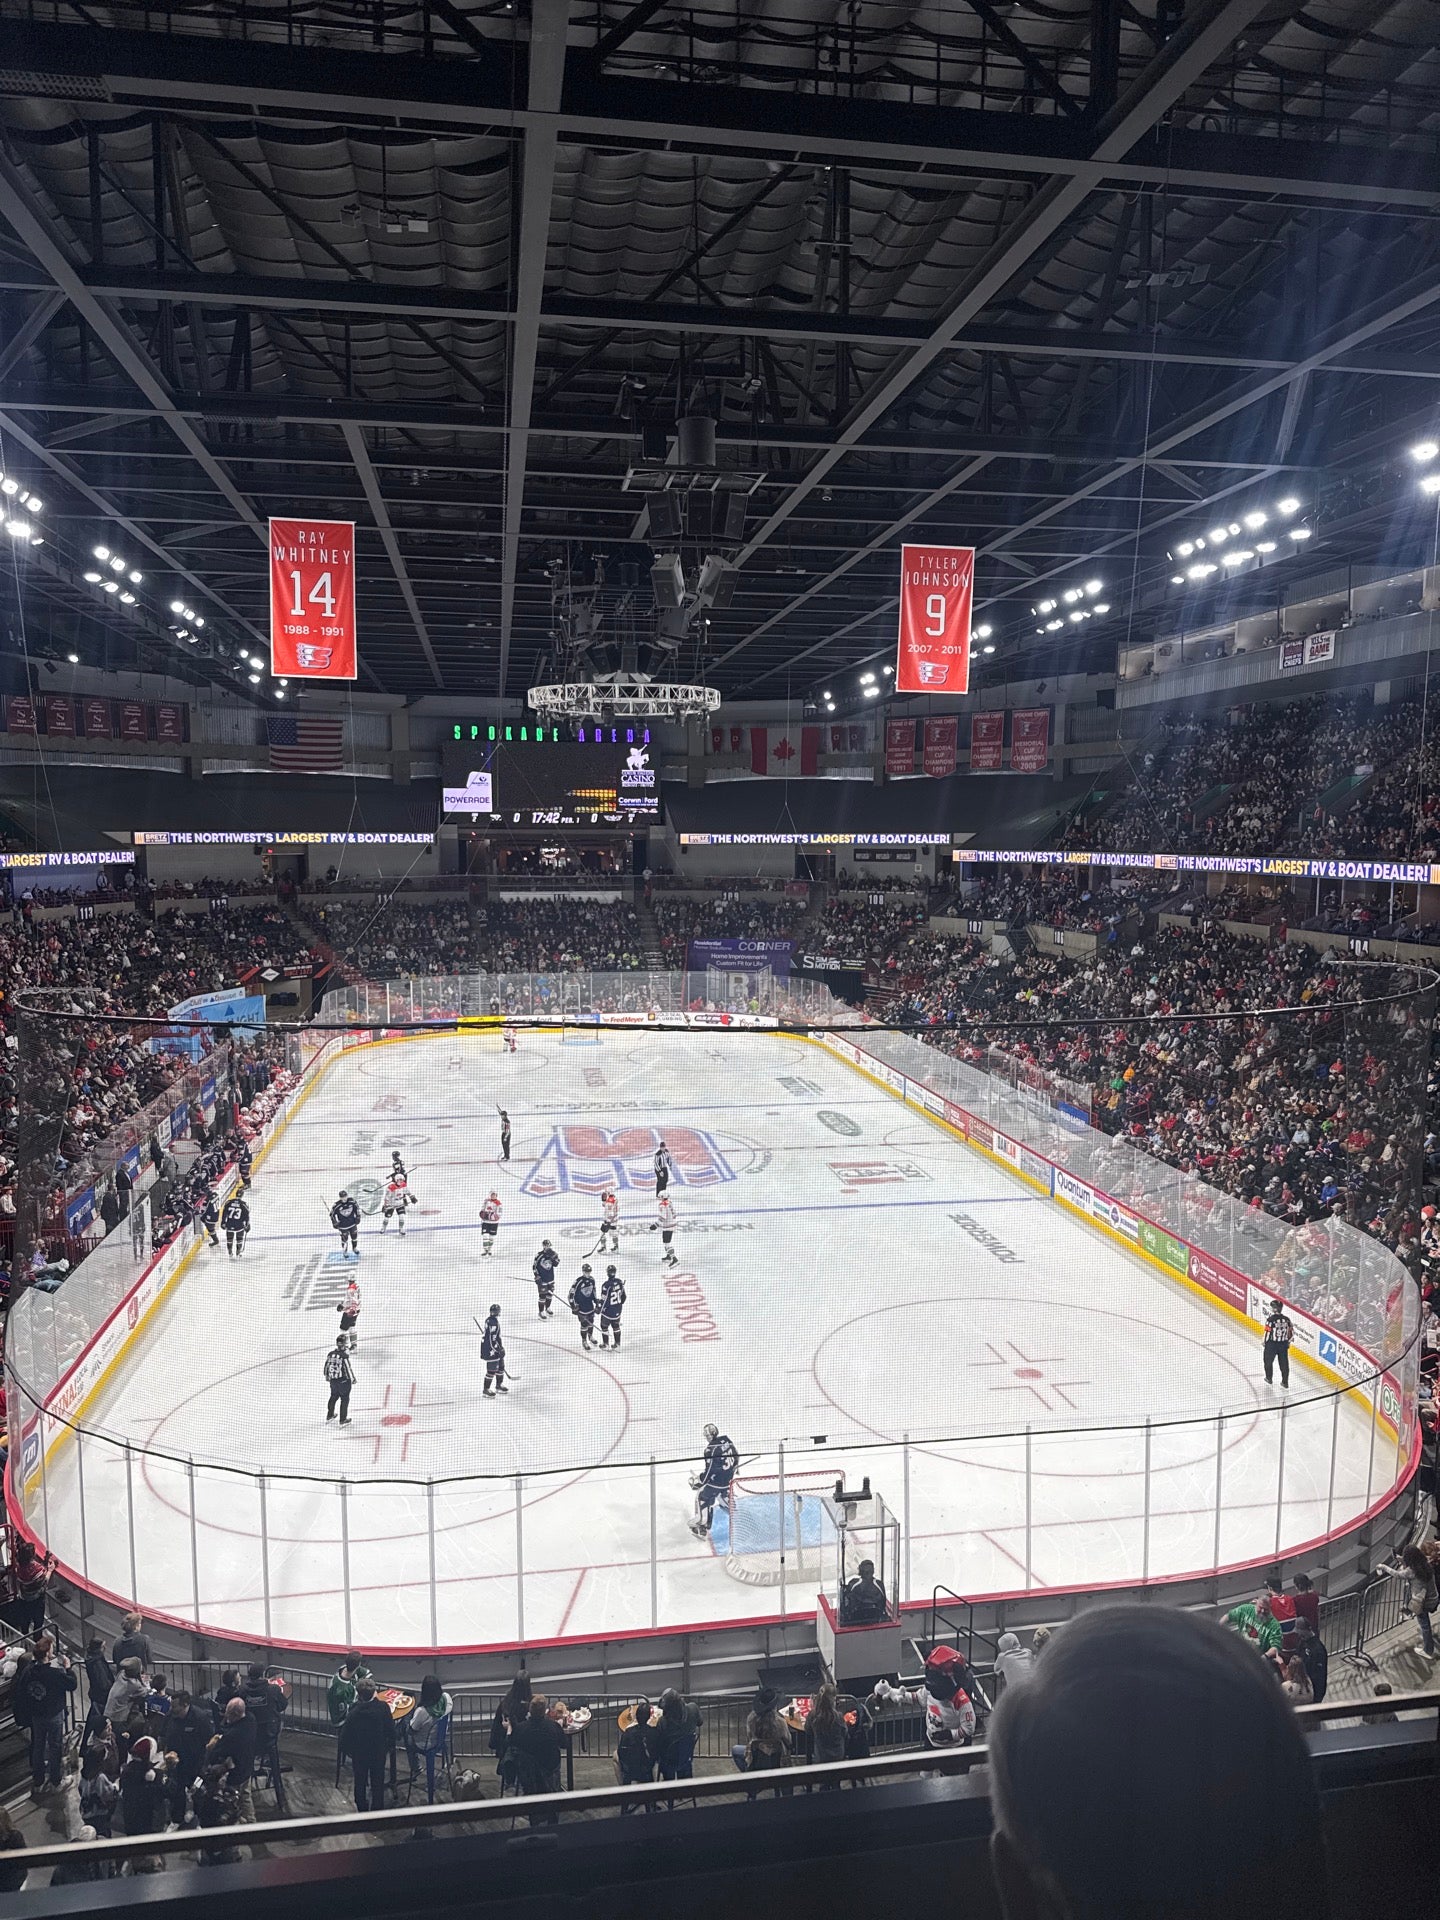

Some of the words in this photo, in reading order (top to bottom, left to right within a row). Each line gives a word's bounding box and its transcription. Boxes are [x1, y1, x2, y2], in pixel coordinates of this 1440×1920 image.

[299, 531, 325, 544] RAY
[274, 546, 350, 565] WHITNEY
[920, 556, 958, 568] TYLER
[905, 572, 969, 588] JOHNSON
[290, 570, 336, 618] 14
[925, 594, 946, 637] 9
[284, 624, 310, 635] 1988
[321, 626, 344, 637] 1991
[908, 644, 933, 654] 2007
[941, 645, 962, 655] 2011
[454, 725, 559, 742] SPOKANE
[578, 728, 650, 743] ARENA
[444, 796, 490, 804] POWERADE
[513, 813, 520, 823] 0
[532, 812, 560, 824] 17:42
[591, 813, 598, 823] 0
[171, 833, 192, 844] THE
[194, 832, 274, 844] NORTHWEST'S
[276, 833, 328, 844] LARGEST
[330, 833, 346, 844] RV
[348, 834, 356, 844] &
[357, 833, 388, 844] BOAT
[389, 833, 434, 844] DEALER!
[712, 834, 732, 844] THE
[734, 834, 808, 844] NORTHWEST'S
[810, 834, 856, 844] LARGEST
[857, 834, 870, 844] RV
[872, 834, 878, 844] &
[880, 834, 908, 844] BOAT
[908, 834, 950, 844] DEALER!
[6, 854, 47, 866] LARGEST
[48, 854, 62, 865] RV
[64, 854, 70, 865] &
[72, 852, 98, 864] BOAT
[98, 851, 135, 864] DEALER!
[978, 851, 994, 862] THE
[996, 851, 1062, 863] NORTHWEST'S
[1064, 853, 1091, 864] LARGEST
[1092, 854, 1100, 864] RV
[1101, 854, 1106, 864] &
[1106, 855, 1125, 866] BOAT
[1126, 855, 1154, 867] DEALER!
[1178, 856, 1194, 869] THE
[1195, 857, 1262, 873] NORTHWEST'S
[1263, 859, 1310, 875] LARGEST
[1312, 861, 1326, 876] RV
[1328, 862, 1336, 876] &
[1338, 862, 1372, 879] BOAT
[1373, 864, 1428, 882] DEALER!
[869, 894, 884, 905] 108
[80, 908, 94, 920] 113
[968, 921, 982, 932] 107
[738, 941, 790, 951] CORNER
[1350, 939, 1368, 956] 104
[814, 962, 840, 970] MOTION
[1057, 1172, 1090, 1204] Quantum
[228, 1208, 241, 1220] 73
[662, 1272, 721, 1342] ROSAUERS
[1338, 1344, 1361, 1368] PACIFIC
